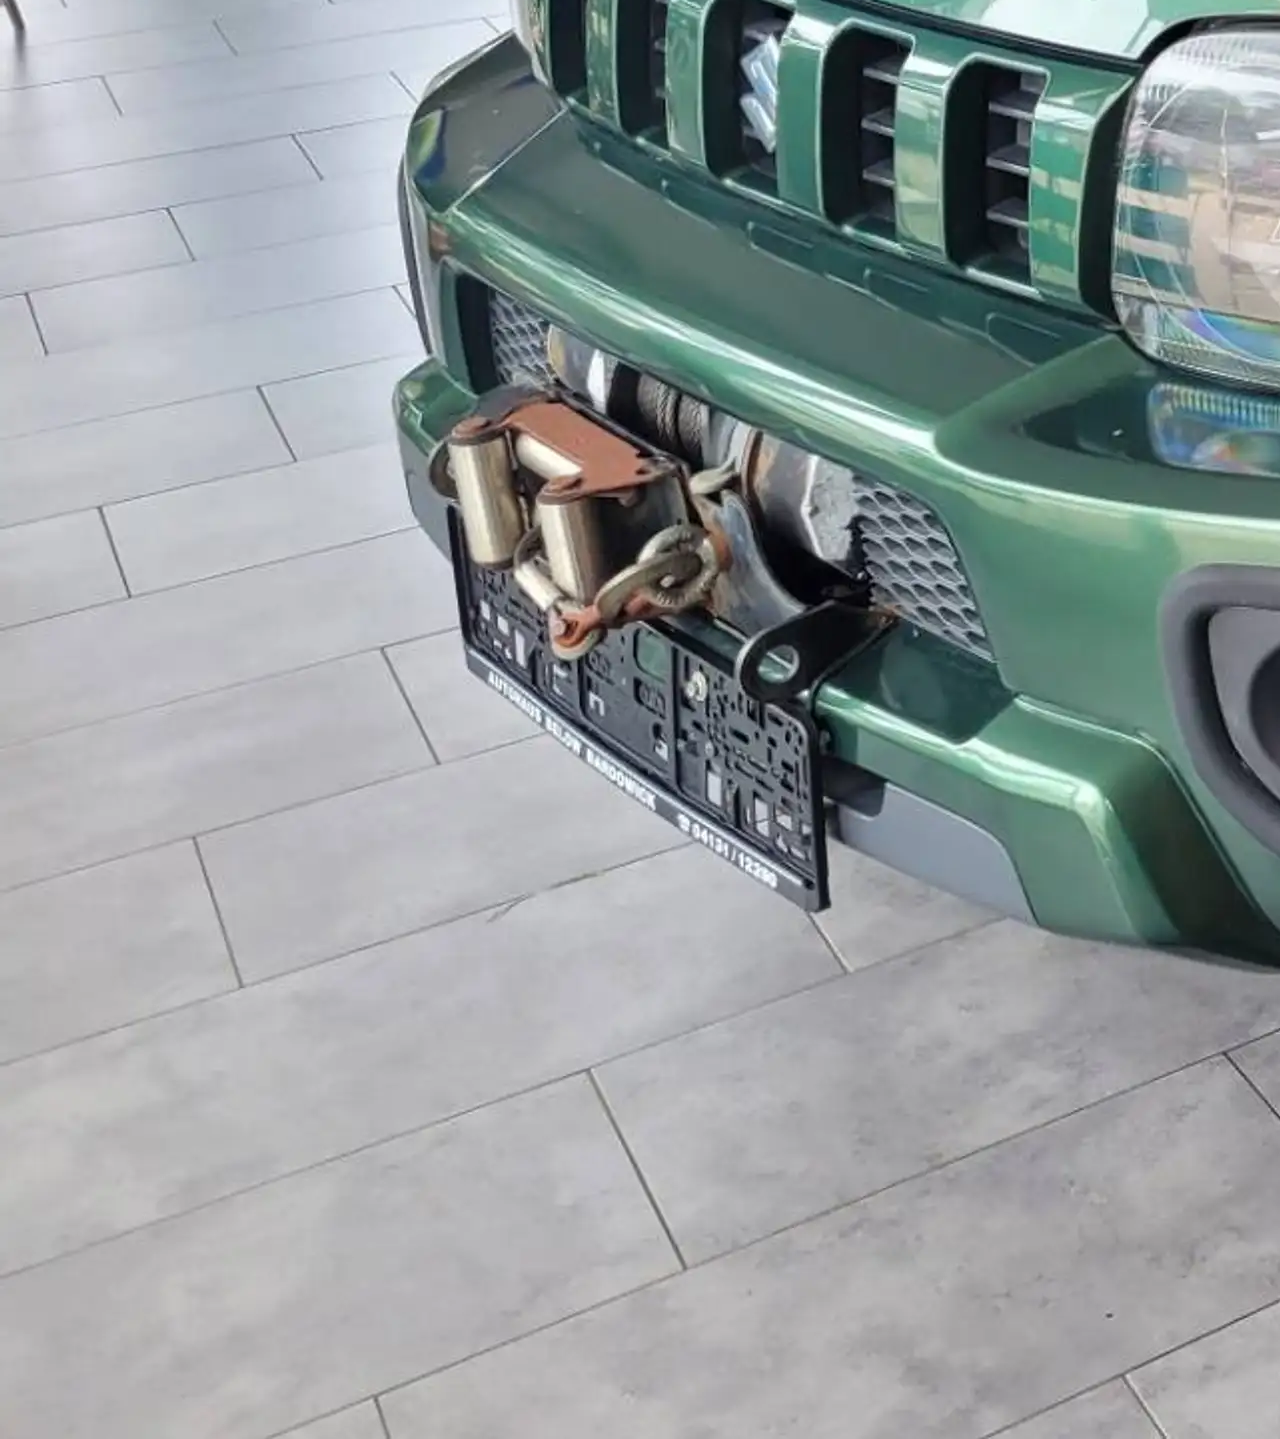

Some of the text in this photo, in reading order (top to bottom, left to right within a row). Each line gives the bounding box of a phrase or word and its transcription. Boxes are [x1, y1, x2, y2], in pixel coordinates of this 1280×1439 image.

[487, 670, 542, 723] AUTOHAUS
[545, 715, 582, 755] BELOW
[586, 747, 657, 811] BARDOWICK
